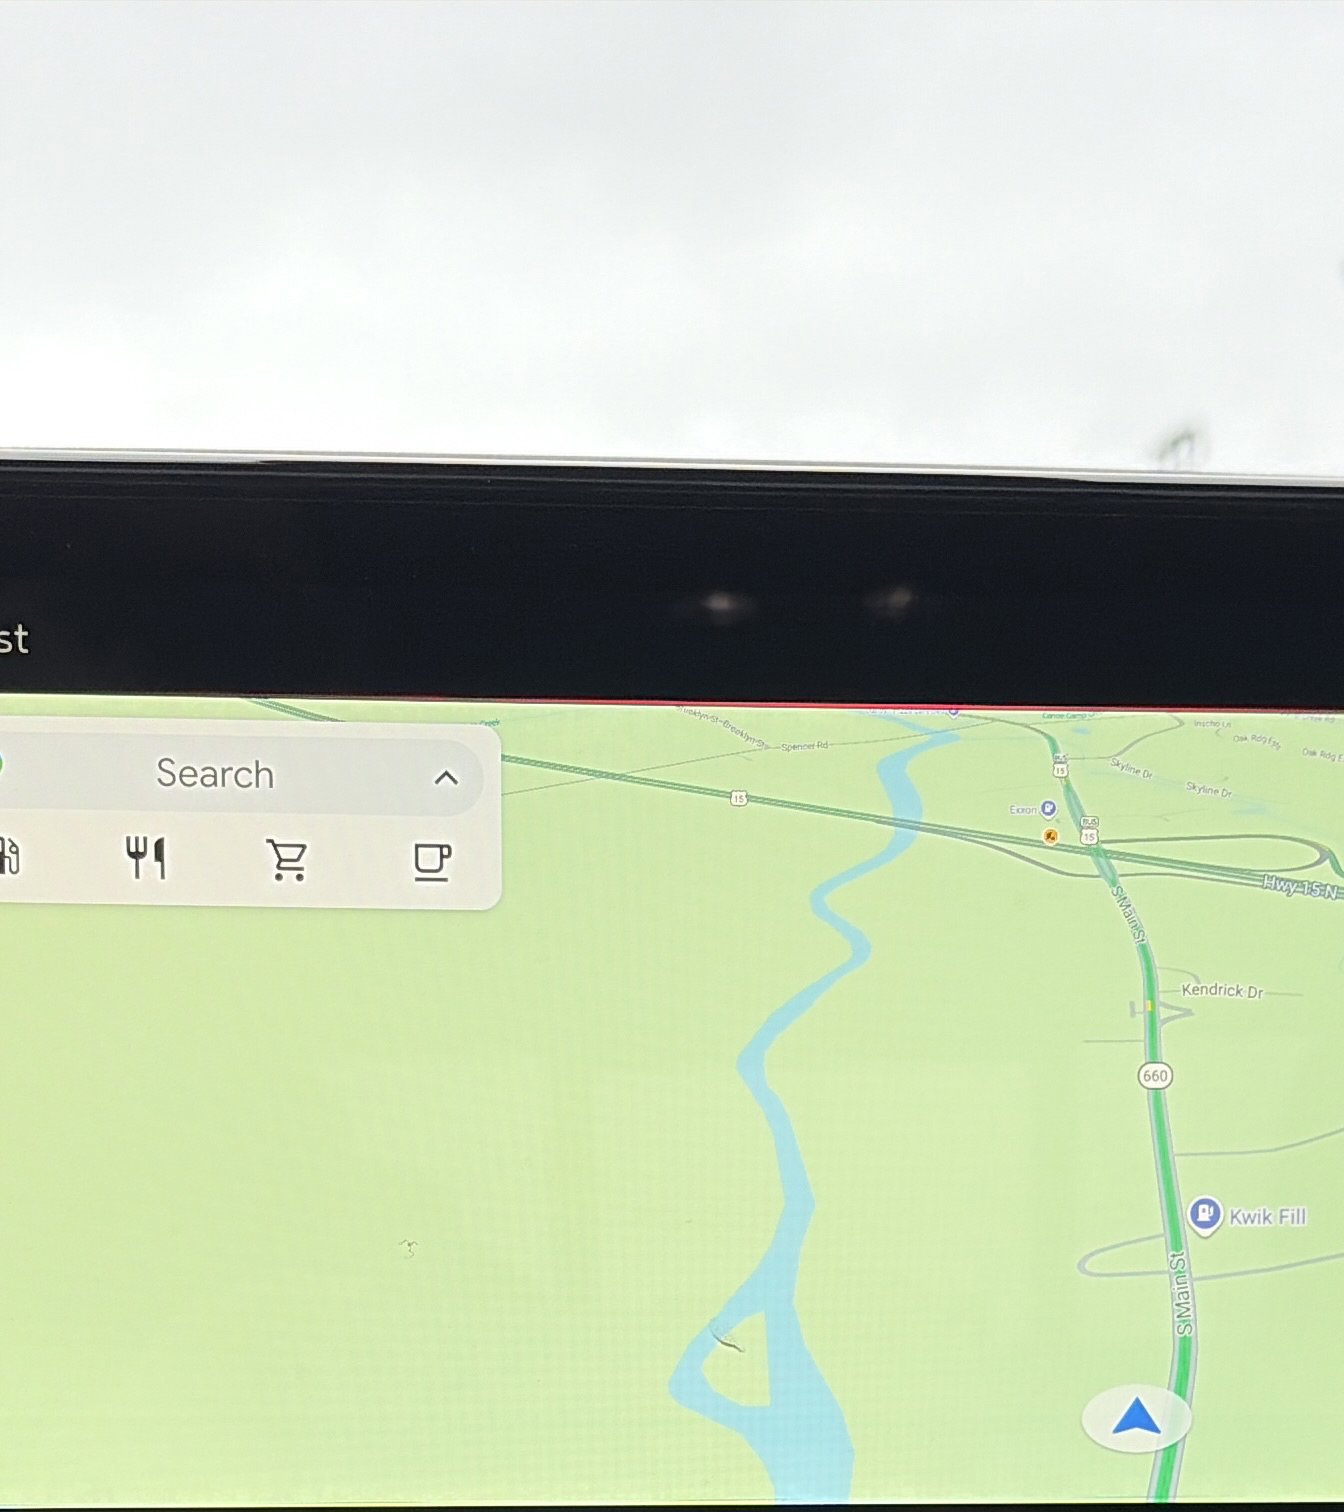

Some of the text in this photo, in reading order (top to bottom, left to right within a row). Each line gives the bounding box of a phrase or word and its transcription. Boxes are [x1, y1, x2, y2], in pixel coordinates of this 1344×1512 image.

[781, 741, 829, 752] Spencer Rd
[156, 756, 275, 791] Search
[1056, 767, 1065, 775] 15
[1111, 757, 1142, 776] Skyline
[1186, 781, 1220, 796] Skyline
[734, 794, 745, 803] 15
[1010, 805, 1037, 815] Exxon
[1084, 832, 1096, 841] 15
[1263, 874, 1338, 900] Hwy 15 N
[1112, 885, 1146, 944] S Main St
[1182, 983, 1263, 999] Kendrick Dr
[1142, 1068, 1169, 1083] 660
[1230, 1207, 1307, 1226] Kwik Fill
[1169, 1251, 1193, 1335] S Main St
